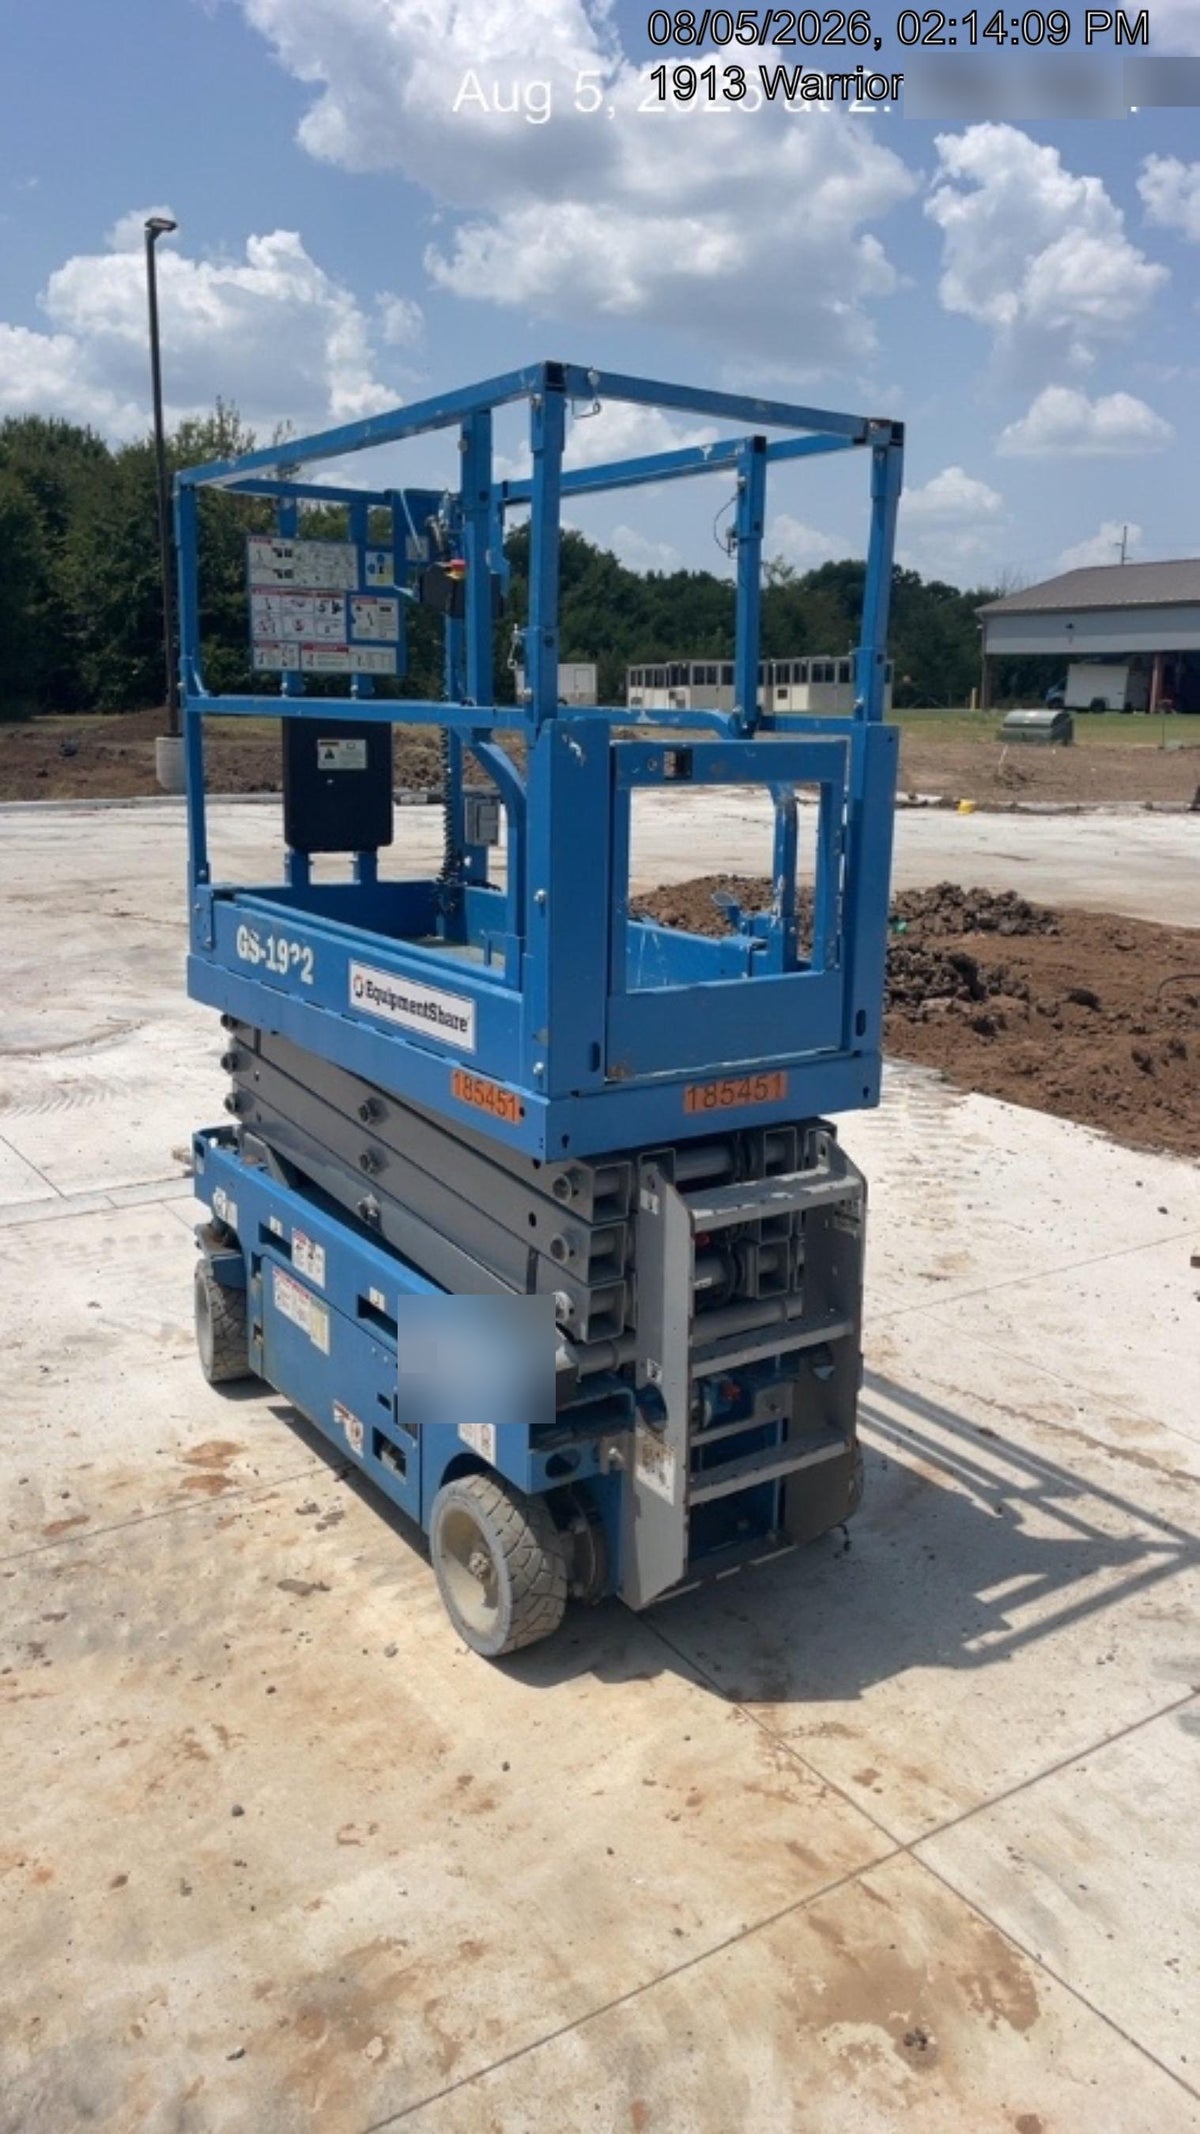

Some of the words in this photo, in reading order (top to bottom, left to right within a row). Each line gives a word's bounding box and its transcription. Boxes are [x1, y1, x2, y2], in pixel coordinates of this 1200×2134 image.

[365, 979, 468, 1032] EquipmentShare
[453, 1070, 517, 1123] 185451
[686, 1072, 782, 1112] 185451
